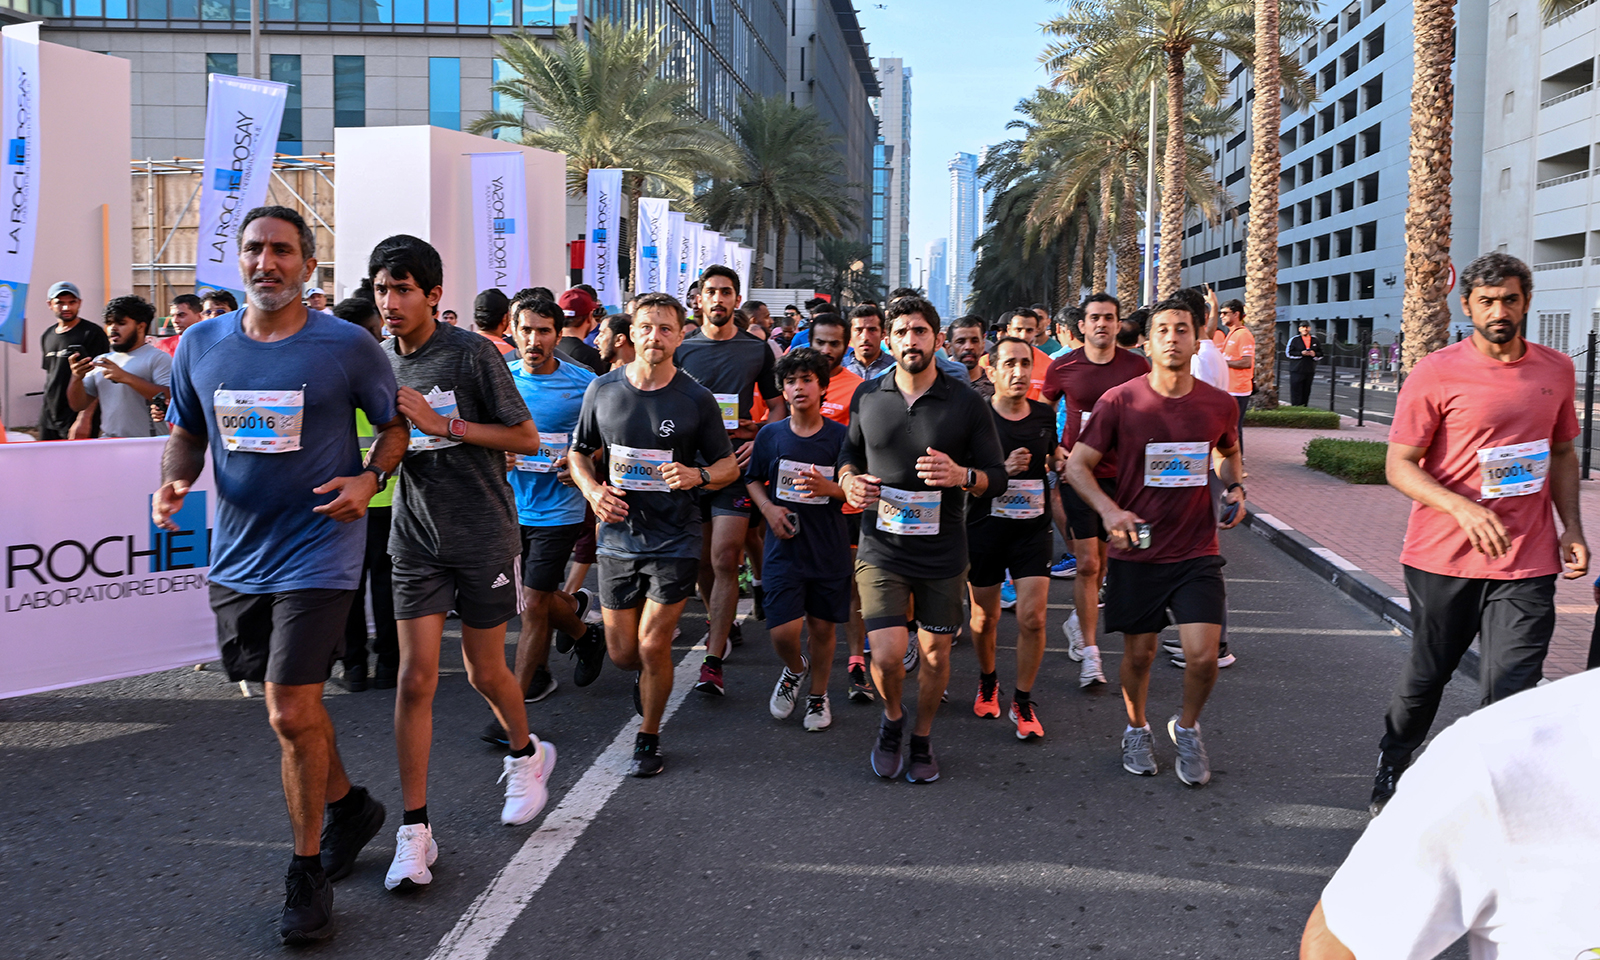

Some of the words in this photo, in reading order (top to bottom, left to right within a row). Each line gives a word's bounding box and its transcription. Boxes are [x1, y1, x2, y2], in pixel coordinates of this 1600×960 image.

[231, 110, 254, 172] POSAY
[10, 144, 26, 223] ROCHE
[214, 175, 242, 239] ROCHE
[597, 190, 608, 230] POSAY
[7, 228, 21, 255] LA
[209, 240, 227, 264] LA
[597, 231, 607, 275] ROCHE
[597, 276, 605, 292] LA
[222, 415, 276, 430] 000016
[614, 462, 653, 476] 000100
[1150, 460, 1191, 471] 000012
[1488, 462, 1533, 480] 100014
[883, 504, 922, 519] 000003
[6, 530, 195, 589] ROCHE
[5, 578, 156, 613] LABORATOIRE
[157, 573, 210, 594] DERM
